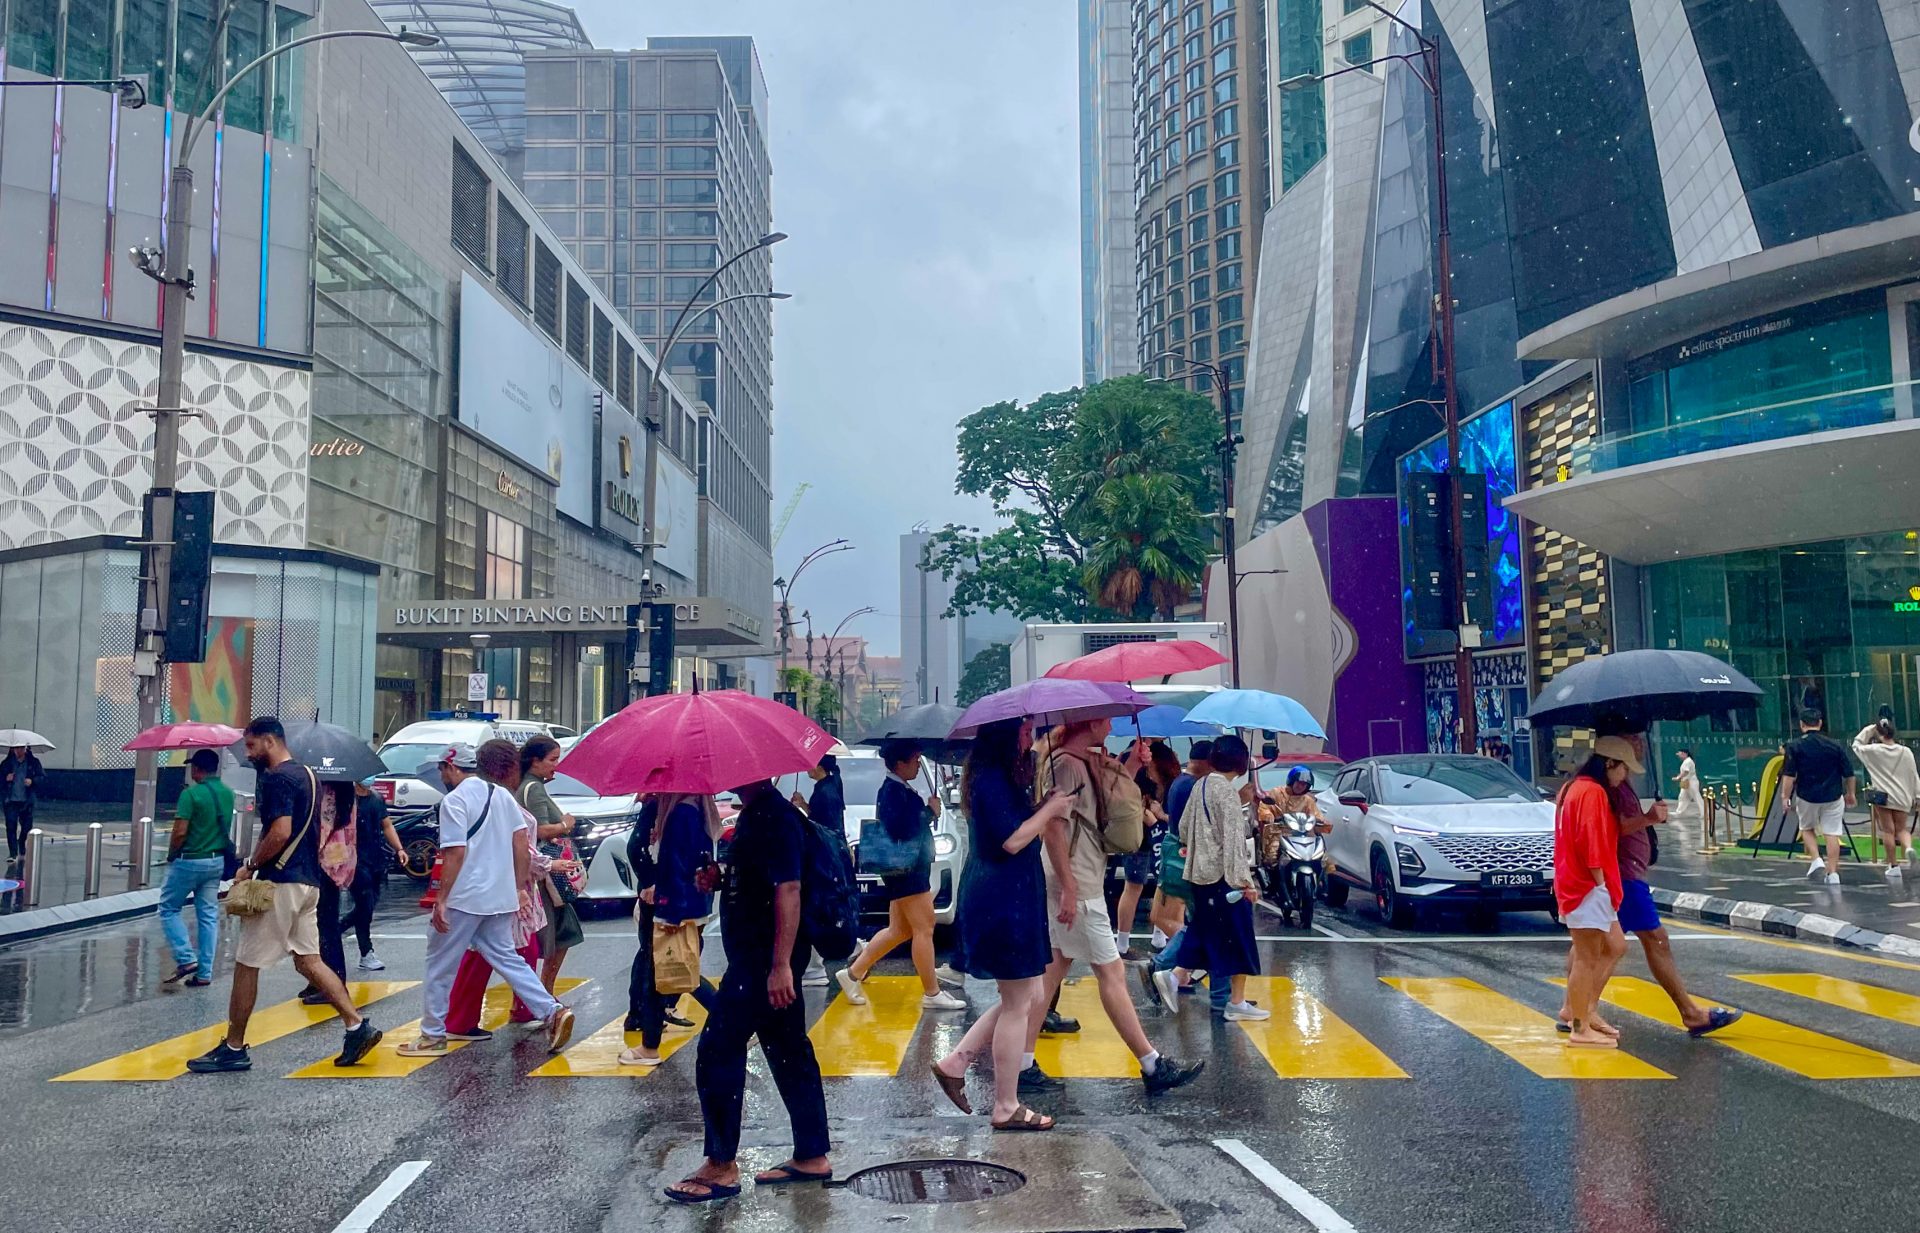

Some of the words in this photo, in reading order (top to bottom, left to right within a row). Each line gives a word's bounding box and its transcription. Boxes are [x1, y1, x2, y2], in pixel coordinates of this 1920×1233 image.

[1691, 339, 1715, 354] eslite
[1716, 326, 1761, 350] spectrum
[606, 480, 640, 526] ROLEX
[395, 607, 465, 625] BUKIT
[471, 605, 572, 624] BINTANG
[578, 604, 700, 622] ENTCE
[1491, 874, 1508, 885] KFT
[1509, 874, 1533, 885] 2383
